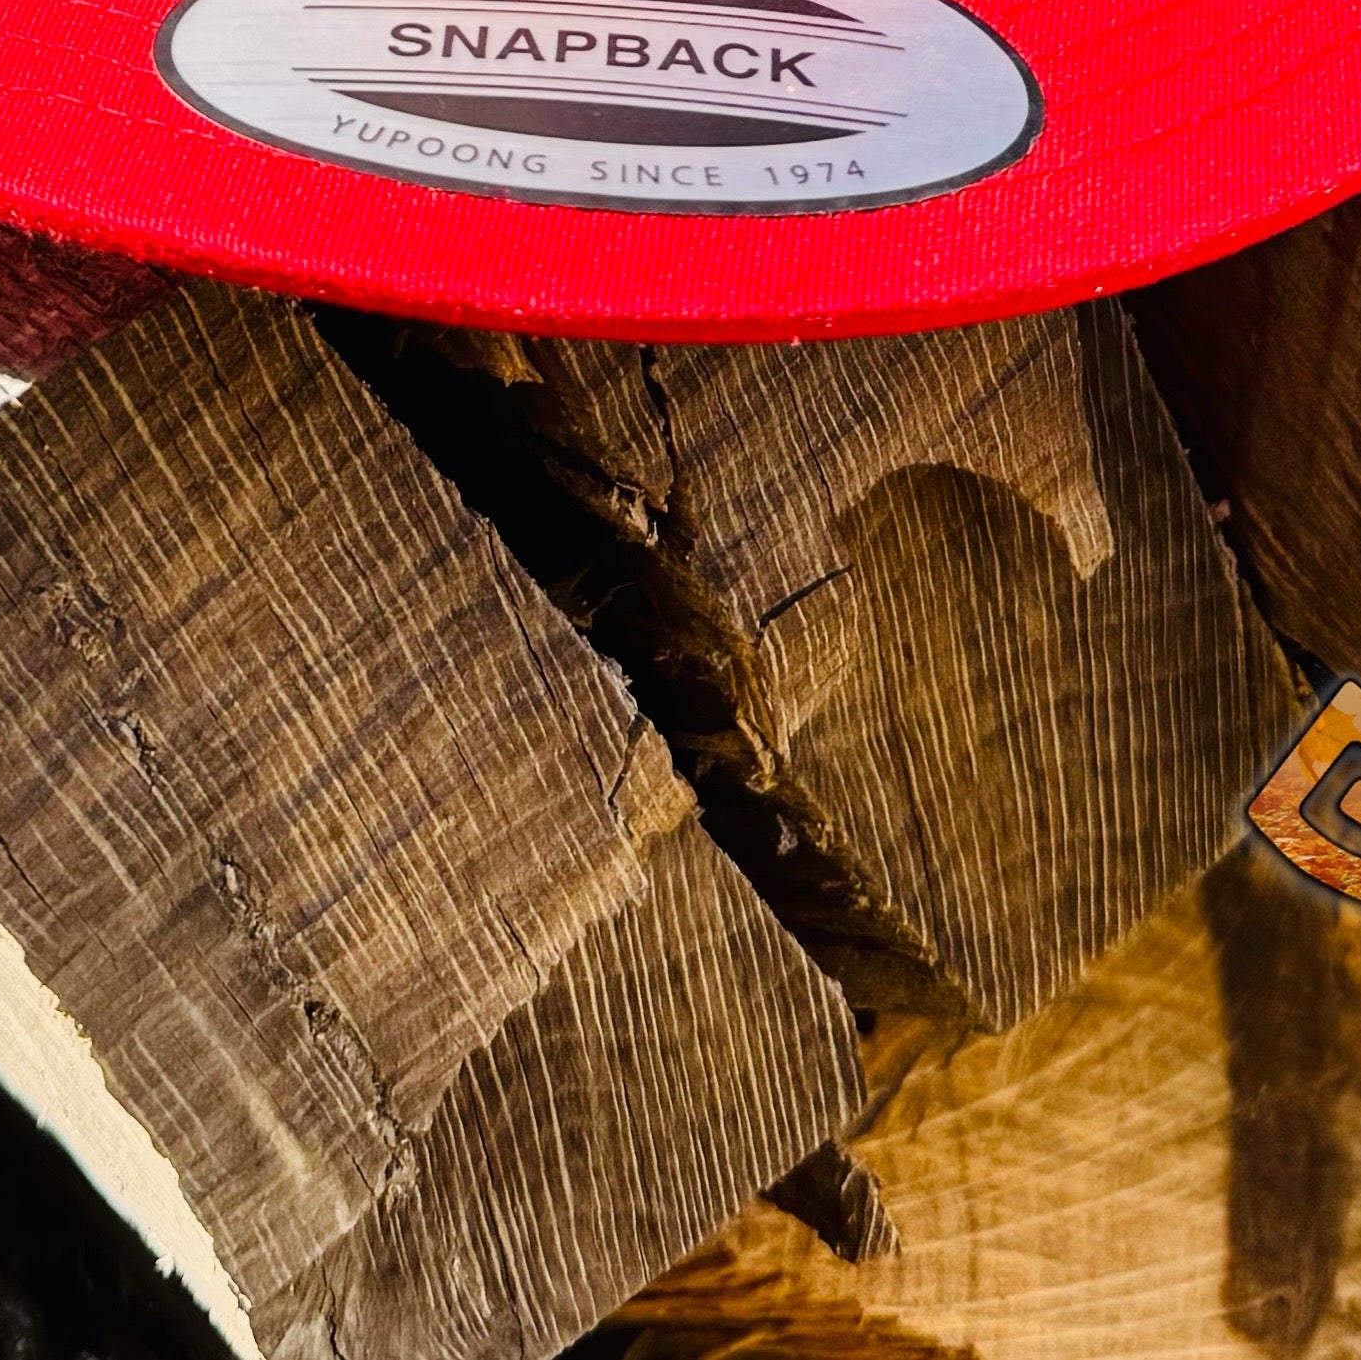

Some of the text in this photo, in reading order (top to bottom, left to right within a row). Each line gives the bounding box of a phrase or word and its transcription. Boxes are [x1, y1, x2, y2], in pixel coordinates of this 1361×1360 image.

[387, 22, 817, 88] SNAPBACK
[332, 114, 866, 186] YUPOONG SINCE 1974
